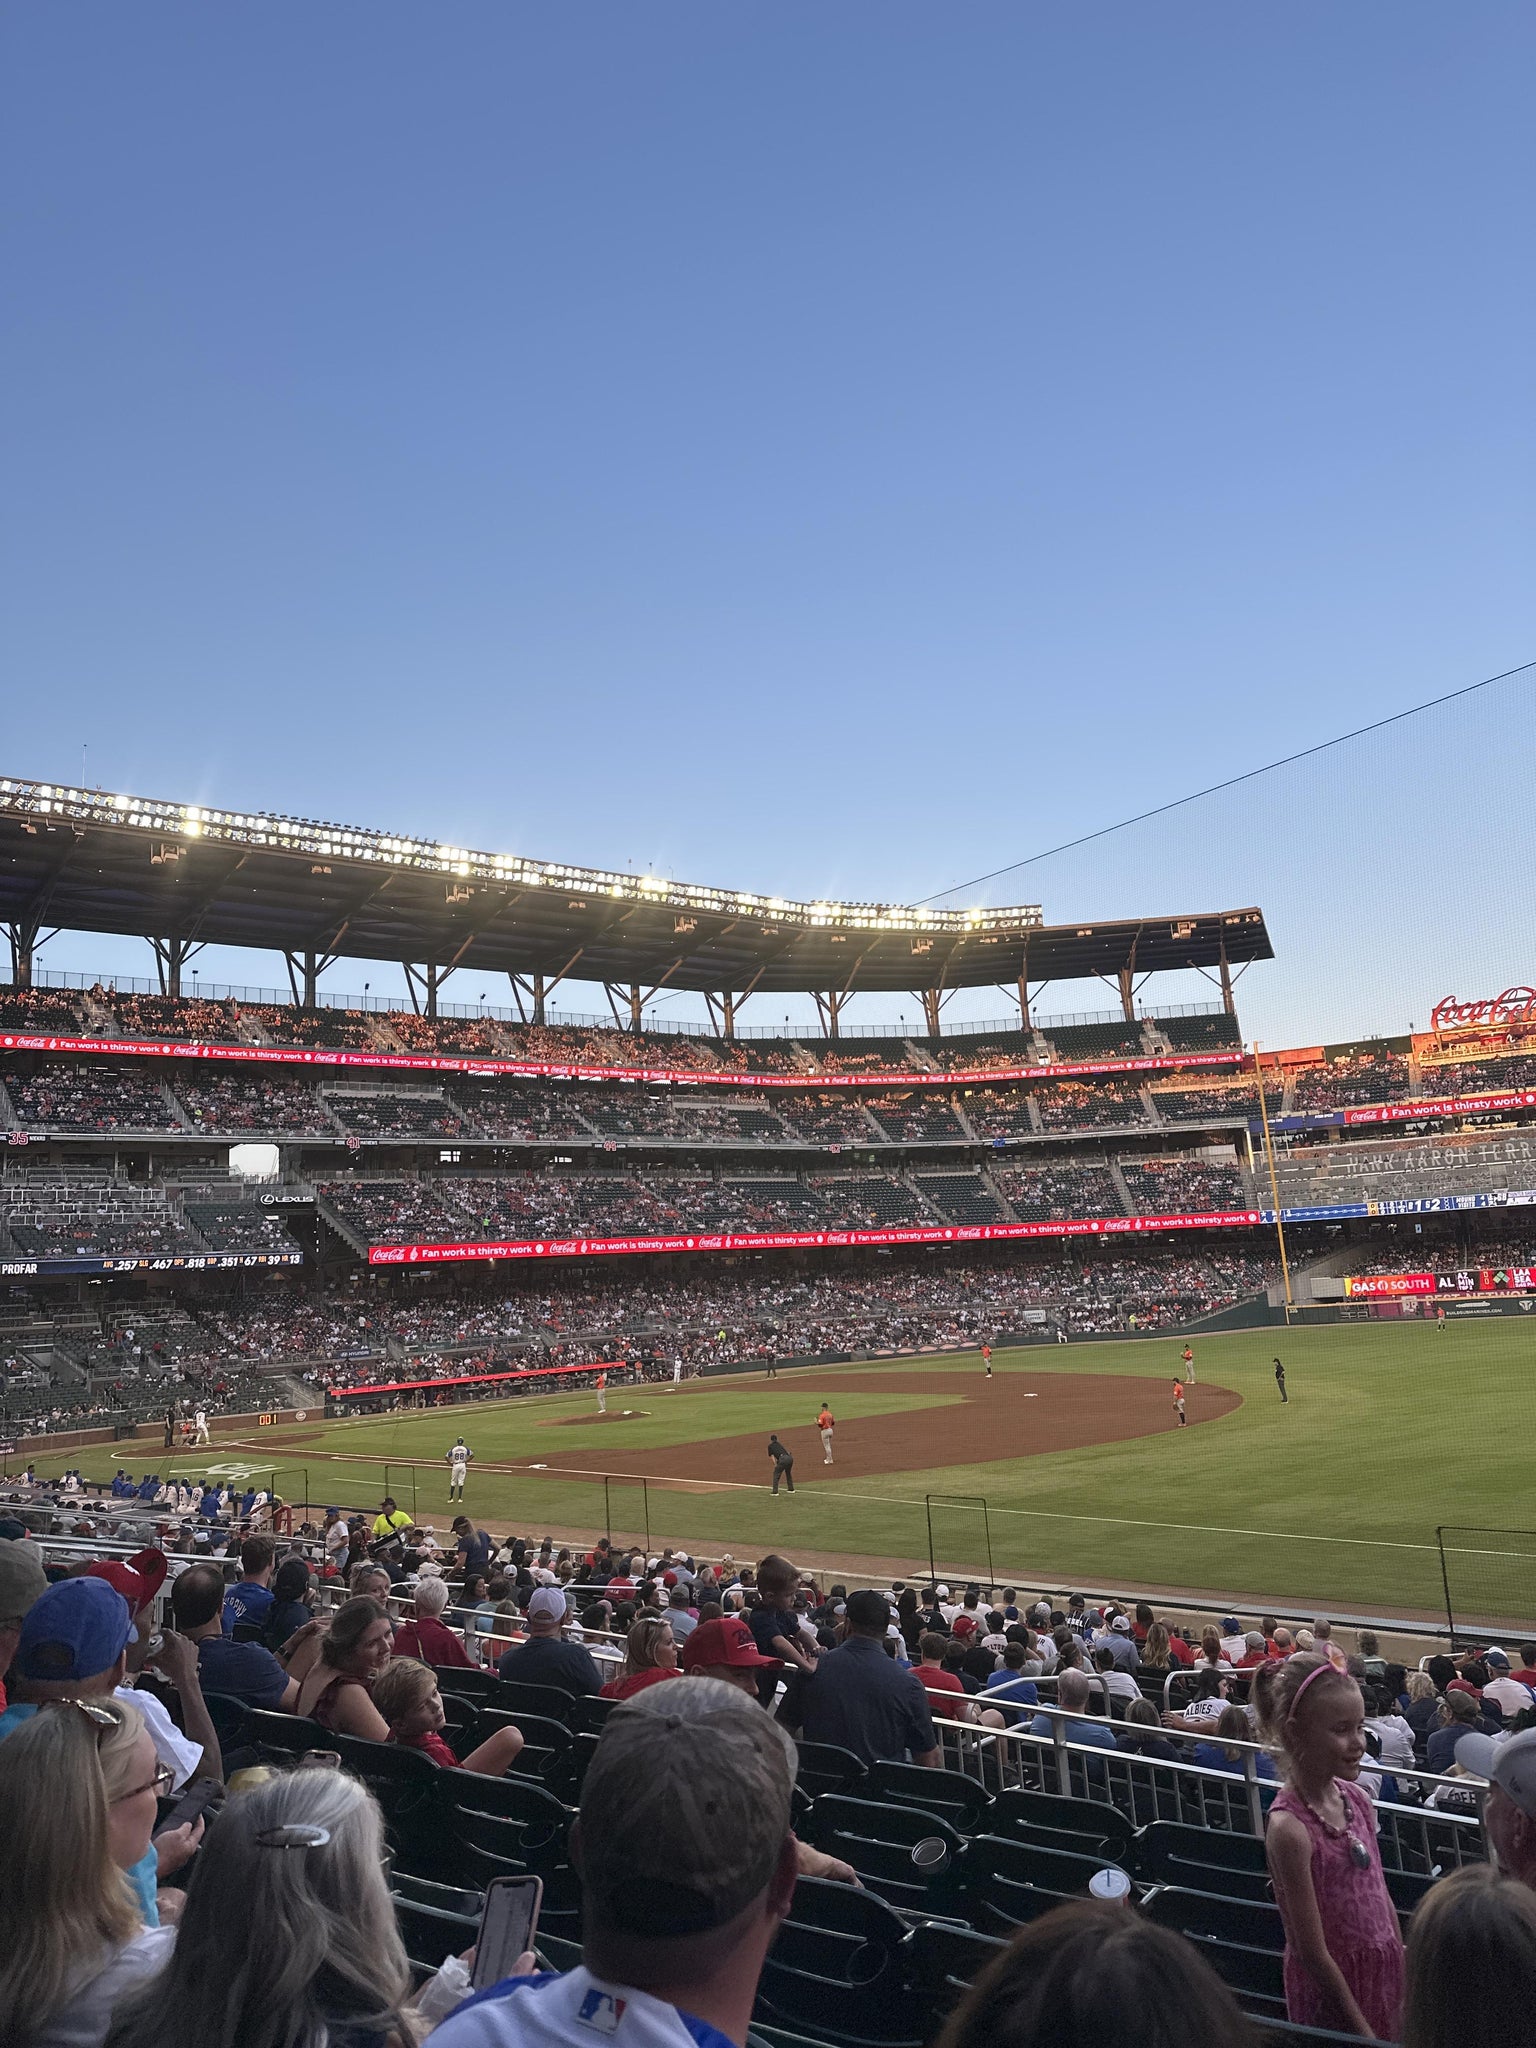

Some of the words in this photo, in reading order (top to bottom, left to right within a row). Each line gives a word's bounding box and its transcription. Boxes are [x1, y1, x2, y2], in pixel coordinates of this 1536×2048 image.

[110, 1045, 137, 1054] thirsty
[257, 1052, 281, 1060] thirsty
[389, 1059, 410, 1067] thirsty
[1392, 1107, 1411, 1118] Fan
[1414, 1104, 1441, 1116] work
[1454, 1098, 1491, 1112] thirsty
[1494, 1096, 1522, 1107] work
[9, 1132, 28, 1145] 35
[346, 1137, 360, 1148] 41
[1347, 1154, 1394, 1173] HANK
[1404, 1147, 1470, 1168] AARON
[1480, 1142, 1533, 1162] TERR
[1431, 1199, 1440, 1209] 2
[1162, 1218, 1183, 1226] work
[1194, 1215, 1222, 1224] thirsty
[1039, 1224, 1065, 1233] thirsty
[1067, 1223, 1088, 1231] work
[775, 1237, 797, 1245] thirsty
[896, 1232, 921, 1240] thirsty
[638, 1240, 664, 1249] thirsty
[423, 1250, 437, 1258] Fan
[440, 1249, 465, 1257] work
[477, 1247, 507, 1256] thirsty
[510, 1246, 532, 1254] work
[114, 1261, 137, 1271] .257
[150, 1260, 172, 1270] .467
[185, 1258, 205, 1268] .818
[218, 1257, 238, 1267] .351
[244, 1256, 257, 1266] 67
[268, 1256, 280, 1265] 39
[290, 1255, 300, 1264] 13
[2, 1264, 38, 1275] PROFAR
[1352, 1282, 1375, 1292] GAS
[1391, 1279, 1430, 1290] SOUTH
[1439, 1277, 1454, 1287] AL
[1186, 1704, 1212, 1716] ALBIES
